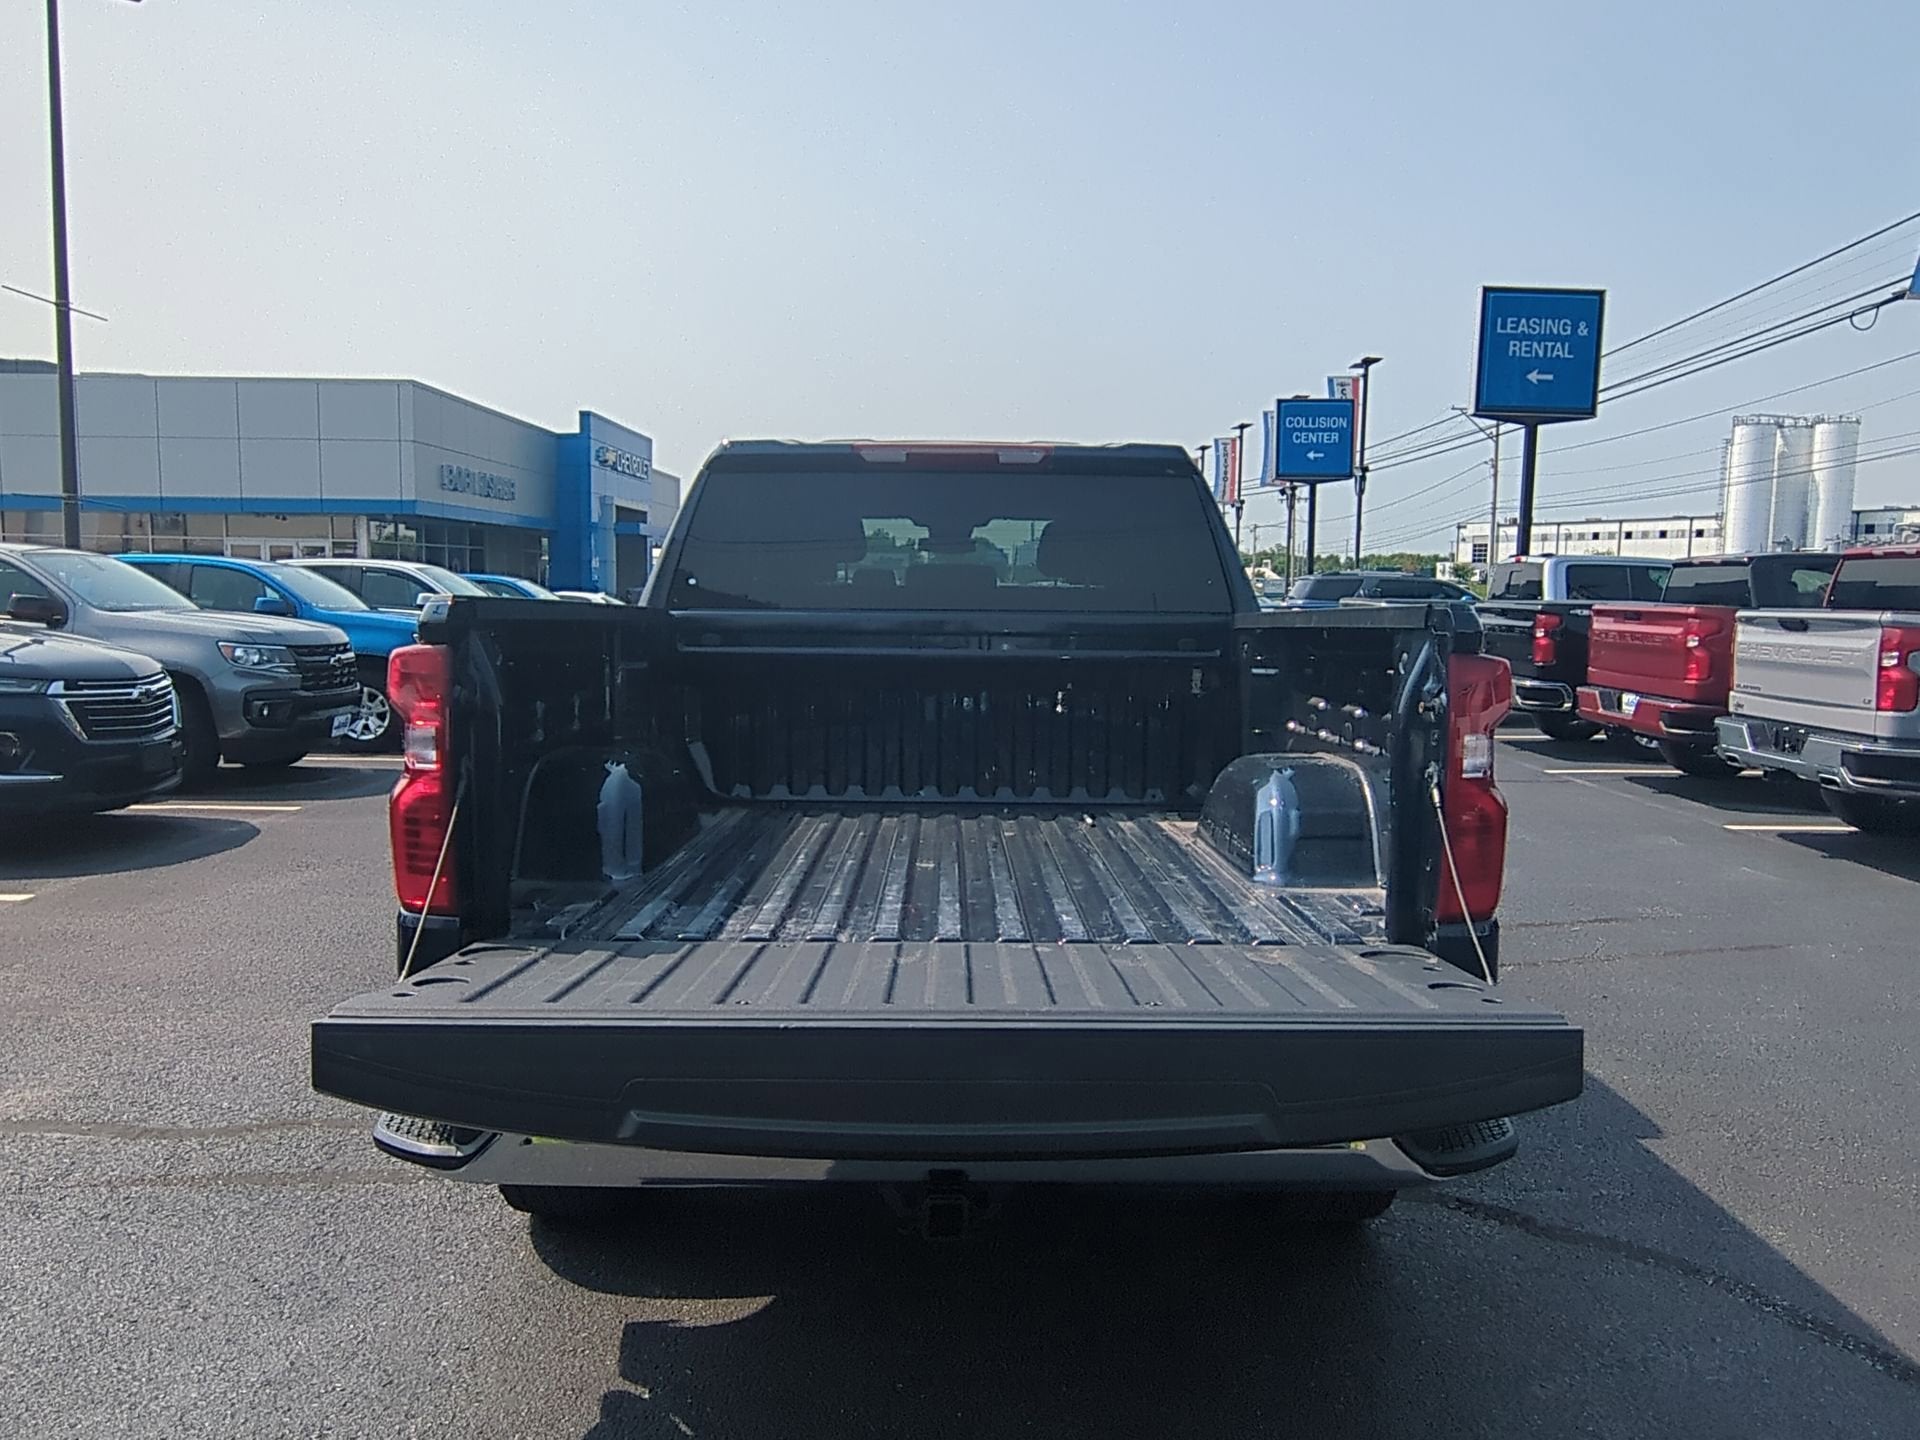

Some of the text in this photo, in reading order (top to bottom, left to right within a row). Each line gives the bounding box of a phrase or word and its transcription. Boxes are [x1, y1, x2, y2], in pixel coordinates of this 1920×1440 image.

[1496, 317, 1589, 336] LEASING &
[1508, 340, 1574, 358] RENTAL
[1285, 416, 1348, 429] COLLISION
[1292, 431, 1340, 444] CENTER
[616, 449, 650, 480] CHEVROLET
[1737, 642, 1863, 665] CHEVROLET
